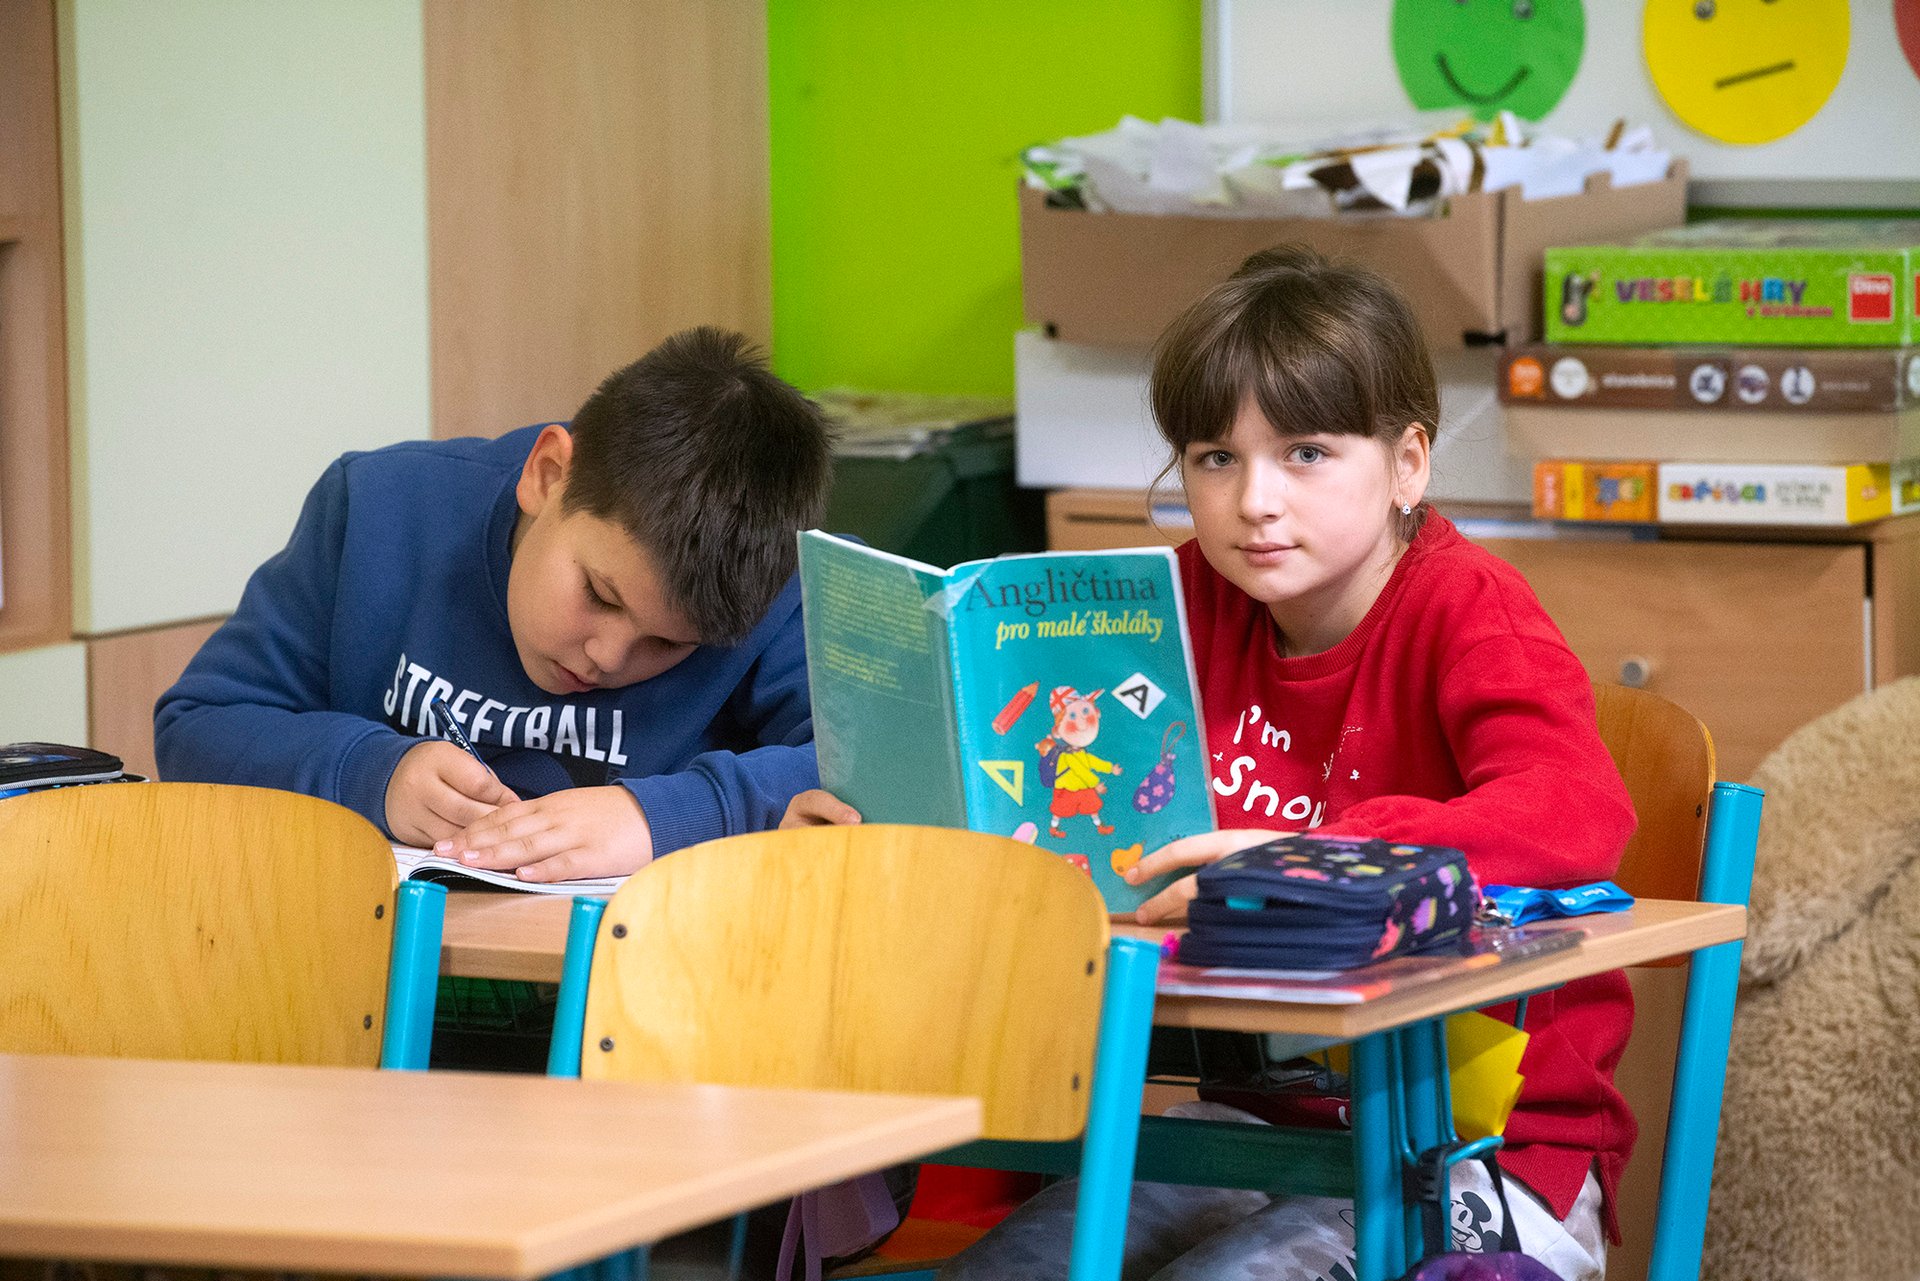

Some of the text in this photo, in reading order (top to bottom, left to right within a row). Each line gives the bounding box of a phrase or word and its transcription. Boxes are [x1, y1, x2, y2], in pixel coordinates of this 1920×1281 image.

[1615, 270, 1806, 303] VESELÉ HRY
[965, 568, 1158, 618] Angličtina
[995, 608, 1164, 650] pro malé školáky
[384, 652, 628, 766] STREETBALL
[1119, 683, 1151, 714] A
